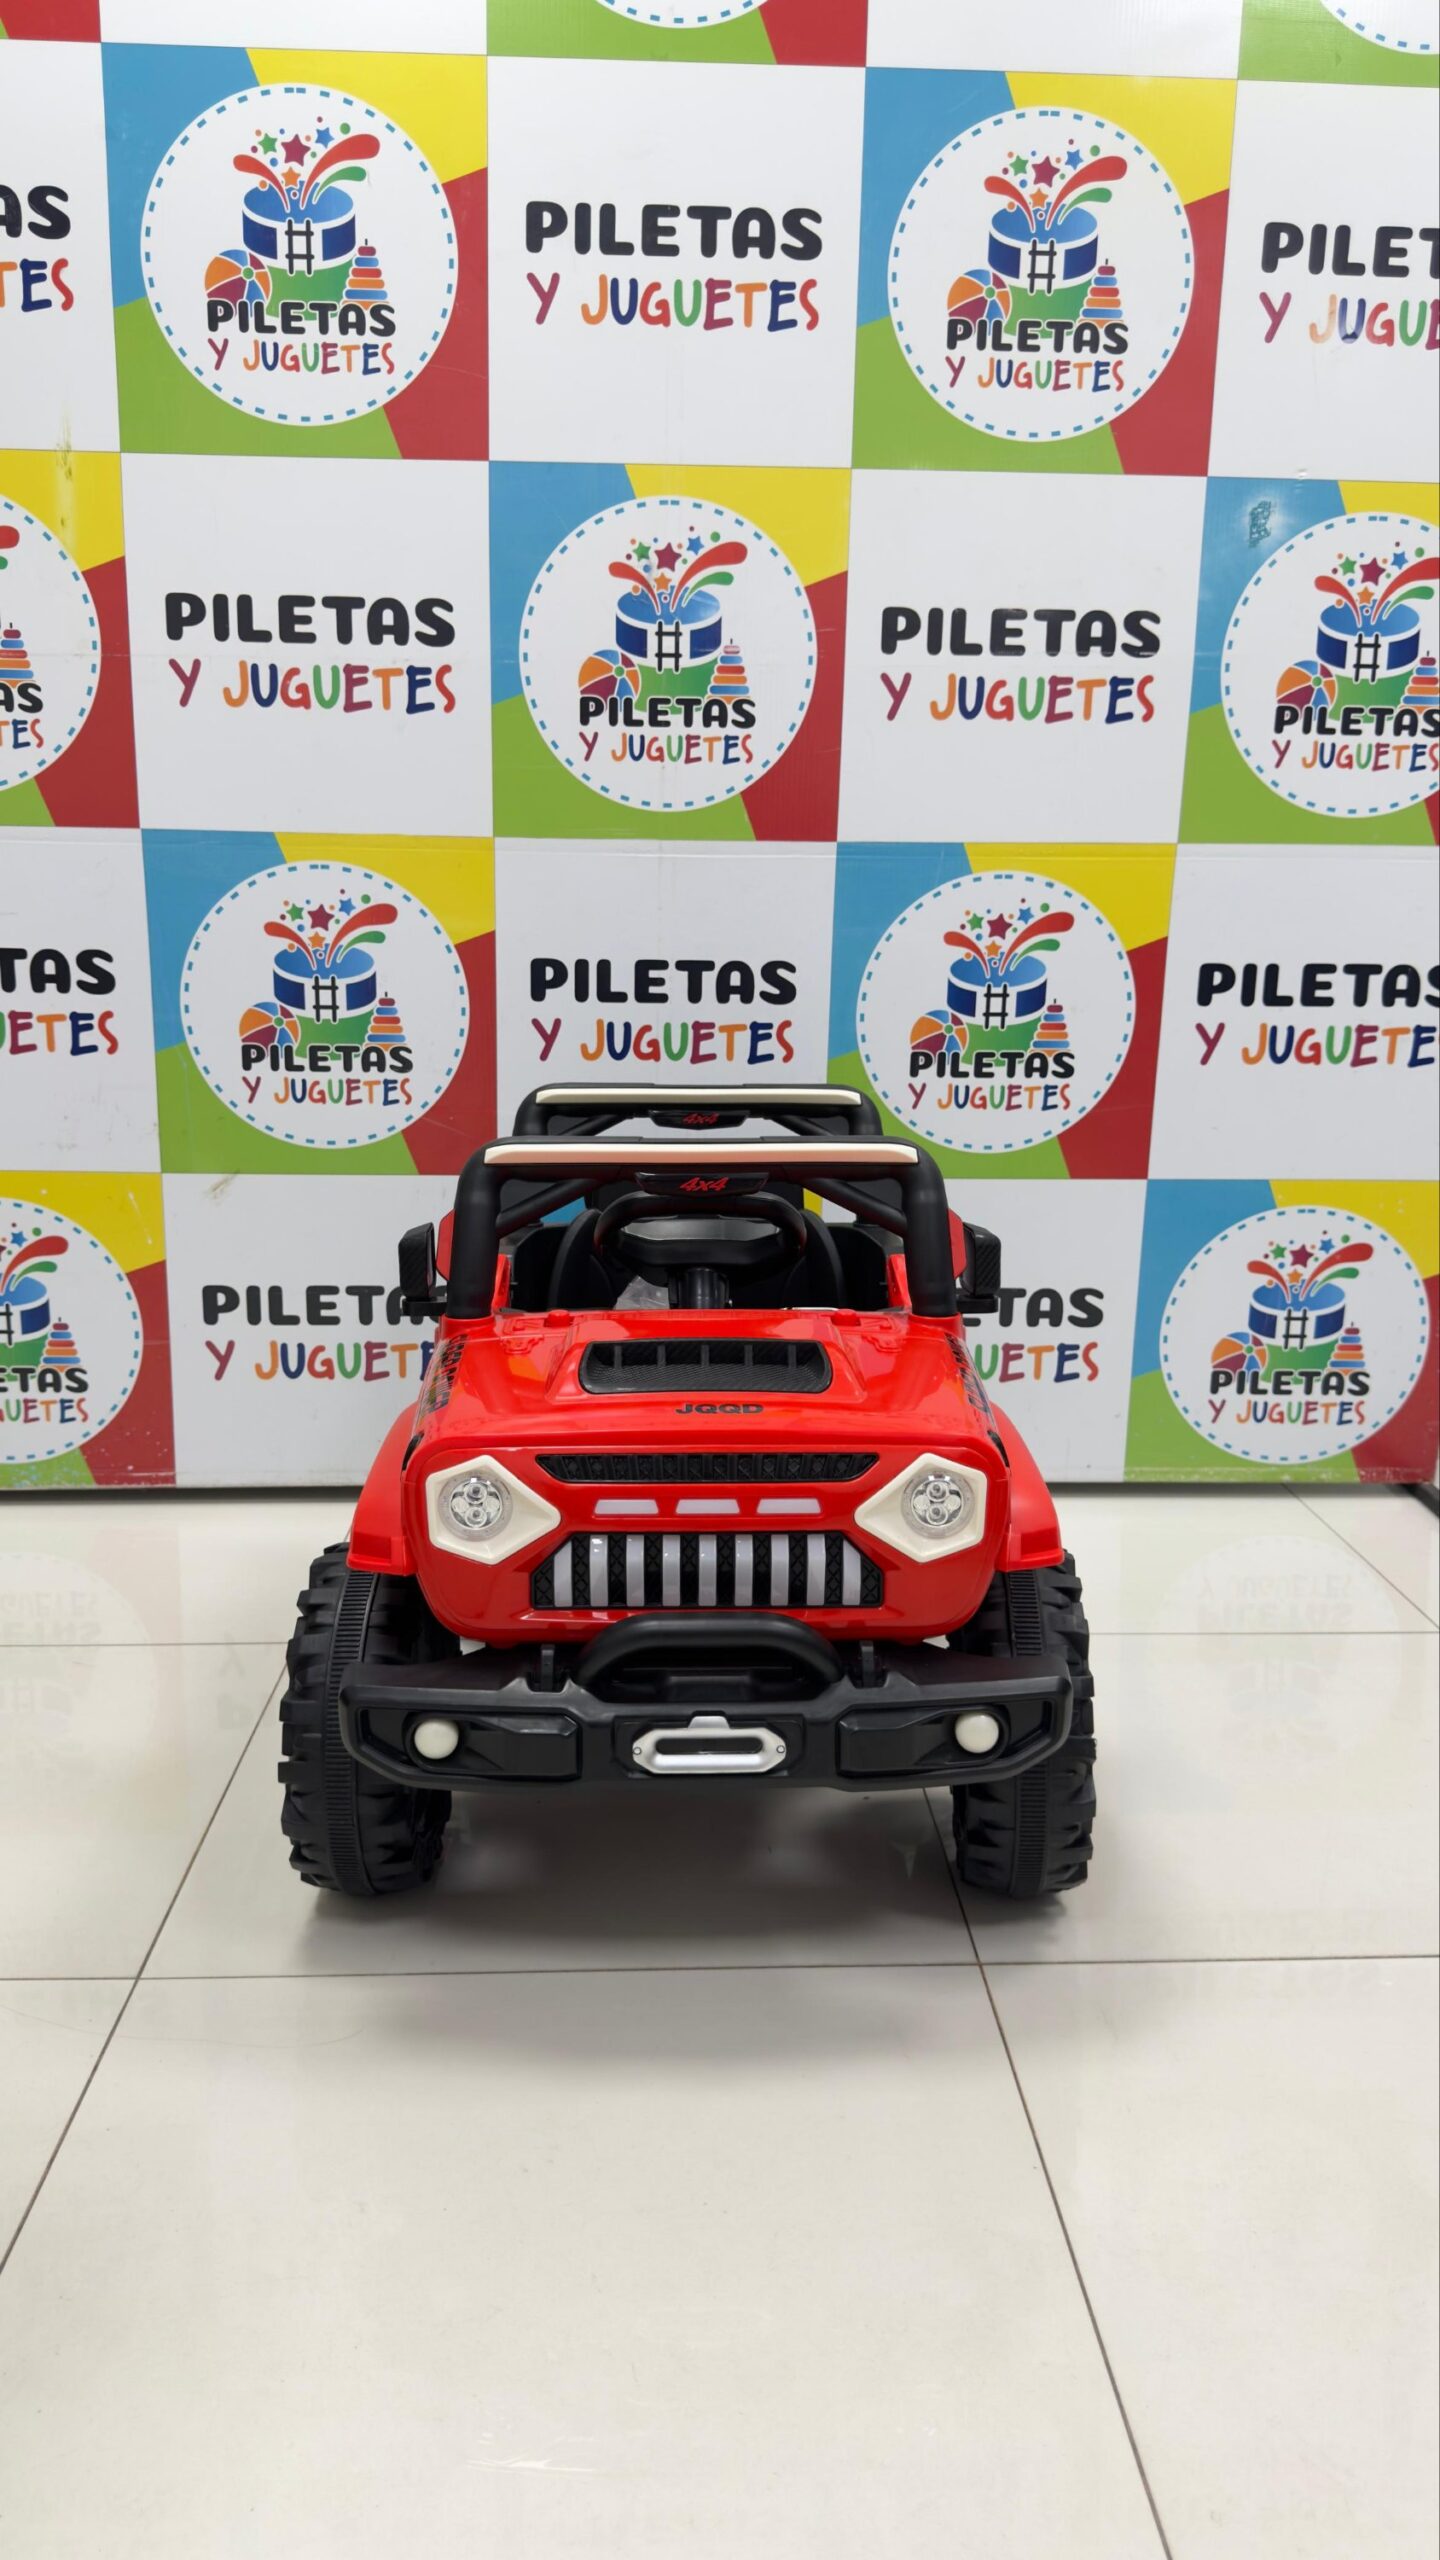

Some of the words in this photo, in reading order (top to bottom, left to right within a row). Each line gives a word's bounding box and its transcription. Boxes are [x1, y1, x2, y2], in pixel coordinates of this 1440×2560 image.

[526, 201, 822, 260] PILETAS
[207, 300, 395, 336] PILETAS
[528, 273, 559, 324] Y
[580, 273, 820, 332] JUGUETES
[1260, 293, 1290, 342] Y
[947, 319, 1128, 354] PILETAS
[208, 339, 229, 371] Y
[243, 339, 394, 374] JUGUETES
[946, 357, 965, 389] Y
[977, 357, 1124, 392] JUGUETES
[166, 593, 455, 647] PILETAS
[882, 607, 1160, 658] PILETAS
[170, 660, 200, 706] Y
[222, 660, 455, 714] JUGUETES
[881, 673, 911, 720] Y
[930, 673, 1155, 723] JUGUETES
[580, 697, 755, 728] PILETAS
[580, 732, 599, 762] Y
[611, 732, 753, 765] JUGUETES
[1272, 740, 1292, 769] Y
[531, 958, 796, 1005] PILETAS
[0, 1010, 118, 1055] ETES
[532, 1019, 560, 1060] Y
[579, 1018, 794, 1064] JUGUETES
[1196, 1023, 1224, 1064] Y
[1241, 1023, 1438, 1067] JUGUETE
[242, 1044, 413, 1073] PILETAS
[910, 1052, 1074, 1078] PILETAS
[243, 1077, 262, 1104] Y
[273, 1077, 412, 1105] JUGUETES
[909, 1083, 927, 1110] Y
[936, 1083, 1070, 1110] JUGUETES
[681, 1112, 720, 1125] 4x4
[679, 1176, 730, 1192] 4x4
[206, 1340, 236, 1382] Y
[1211, 1371, 1370, 1396] PILETAS
[0, 1397, 88, 1423] UETES
[1209, 1399, 1226, 1424] Y
[1235, 1400, 1365, 1424] JUGUETES
